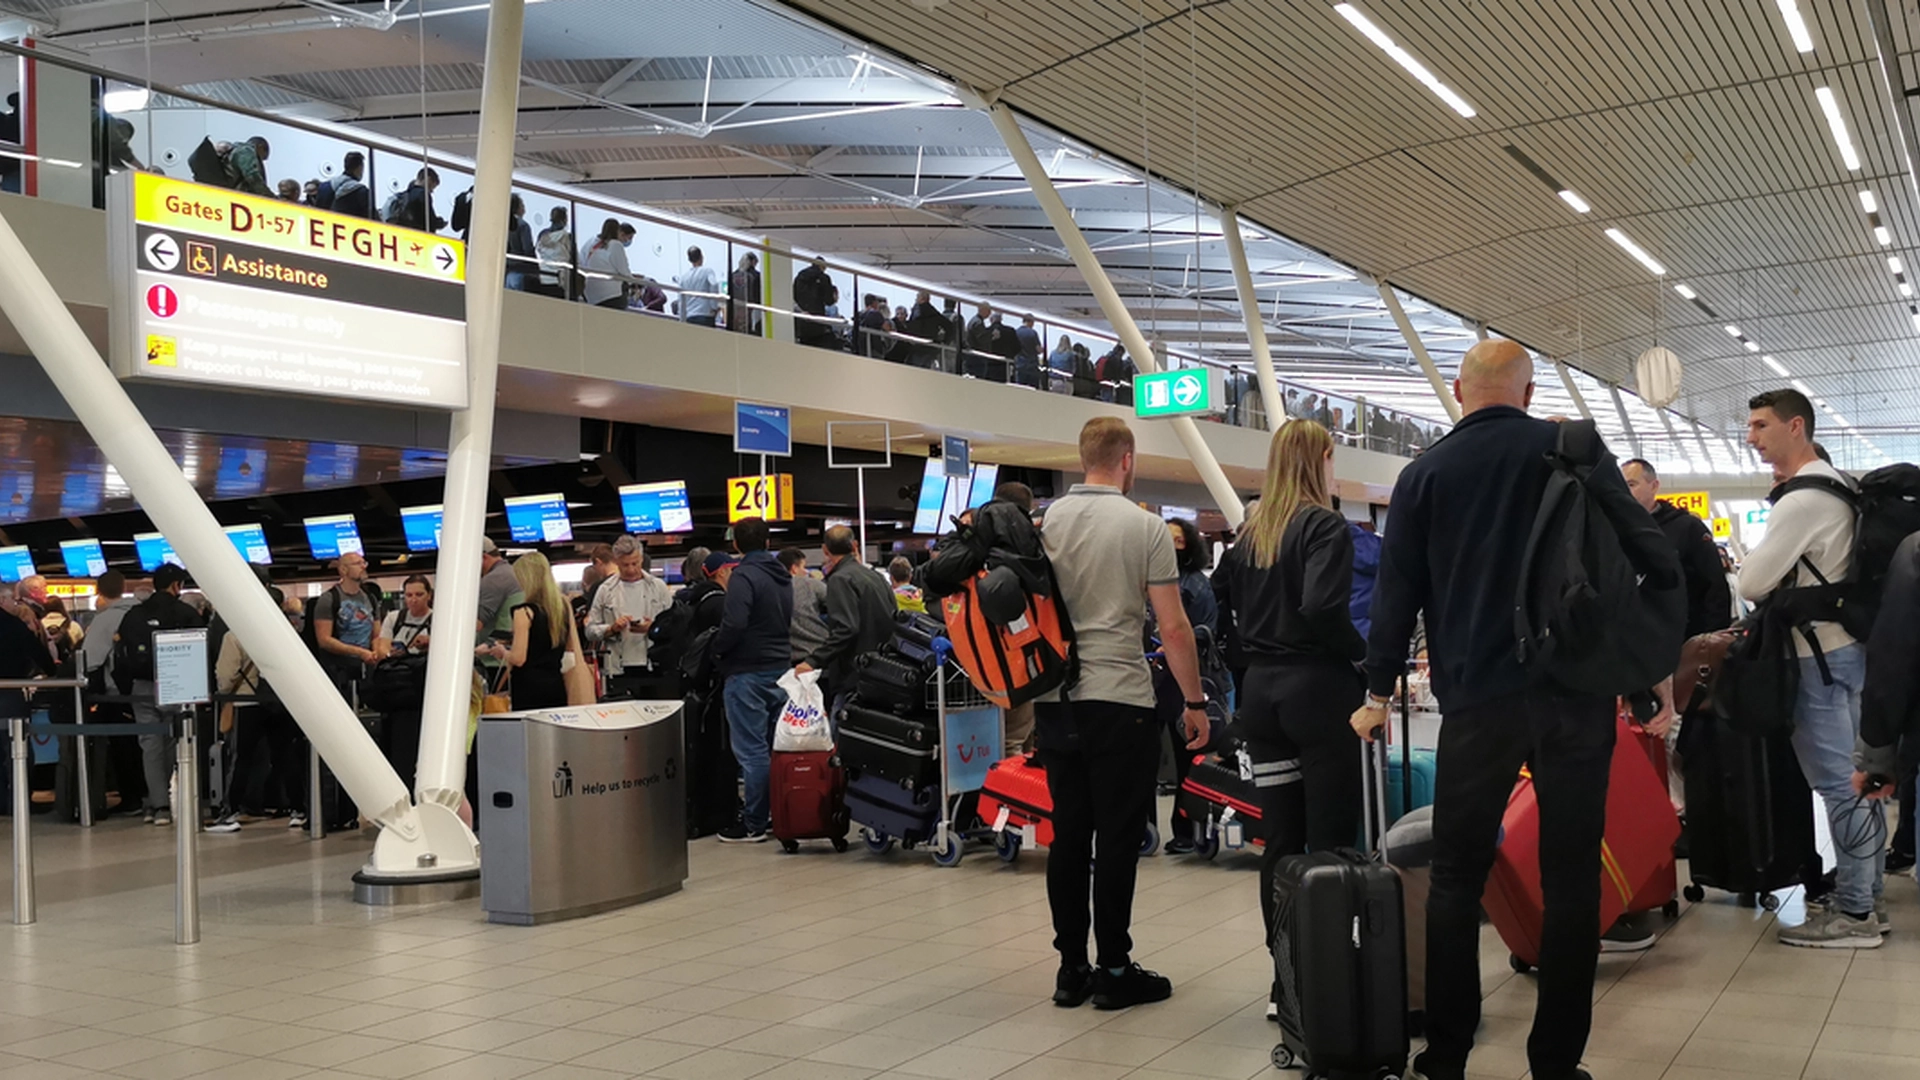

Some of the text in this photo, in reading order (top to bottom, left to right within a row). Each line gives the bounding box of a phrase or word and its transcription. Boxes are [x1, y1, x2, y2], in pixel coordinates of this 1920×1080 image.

[165, 195, 223, 222] Gates
[222, 253, 328, 288] Assistance
[184, 294, 345, 340] Passengers only
[182, 338, 218, 356] Keep
[183, 356, 430, 397] Paspoort en boarding pass gereedhouden
[735, 479, 770, 511] 26
[582, 773, 660, 795] Help us to recycle
